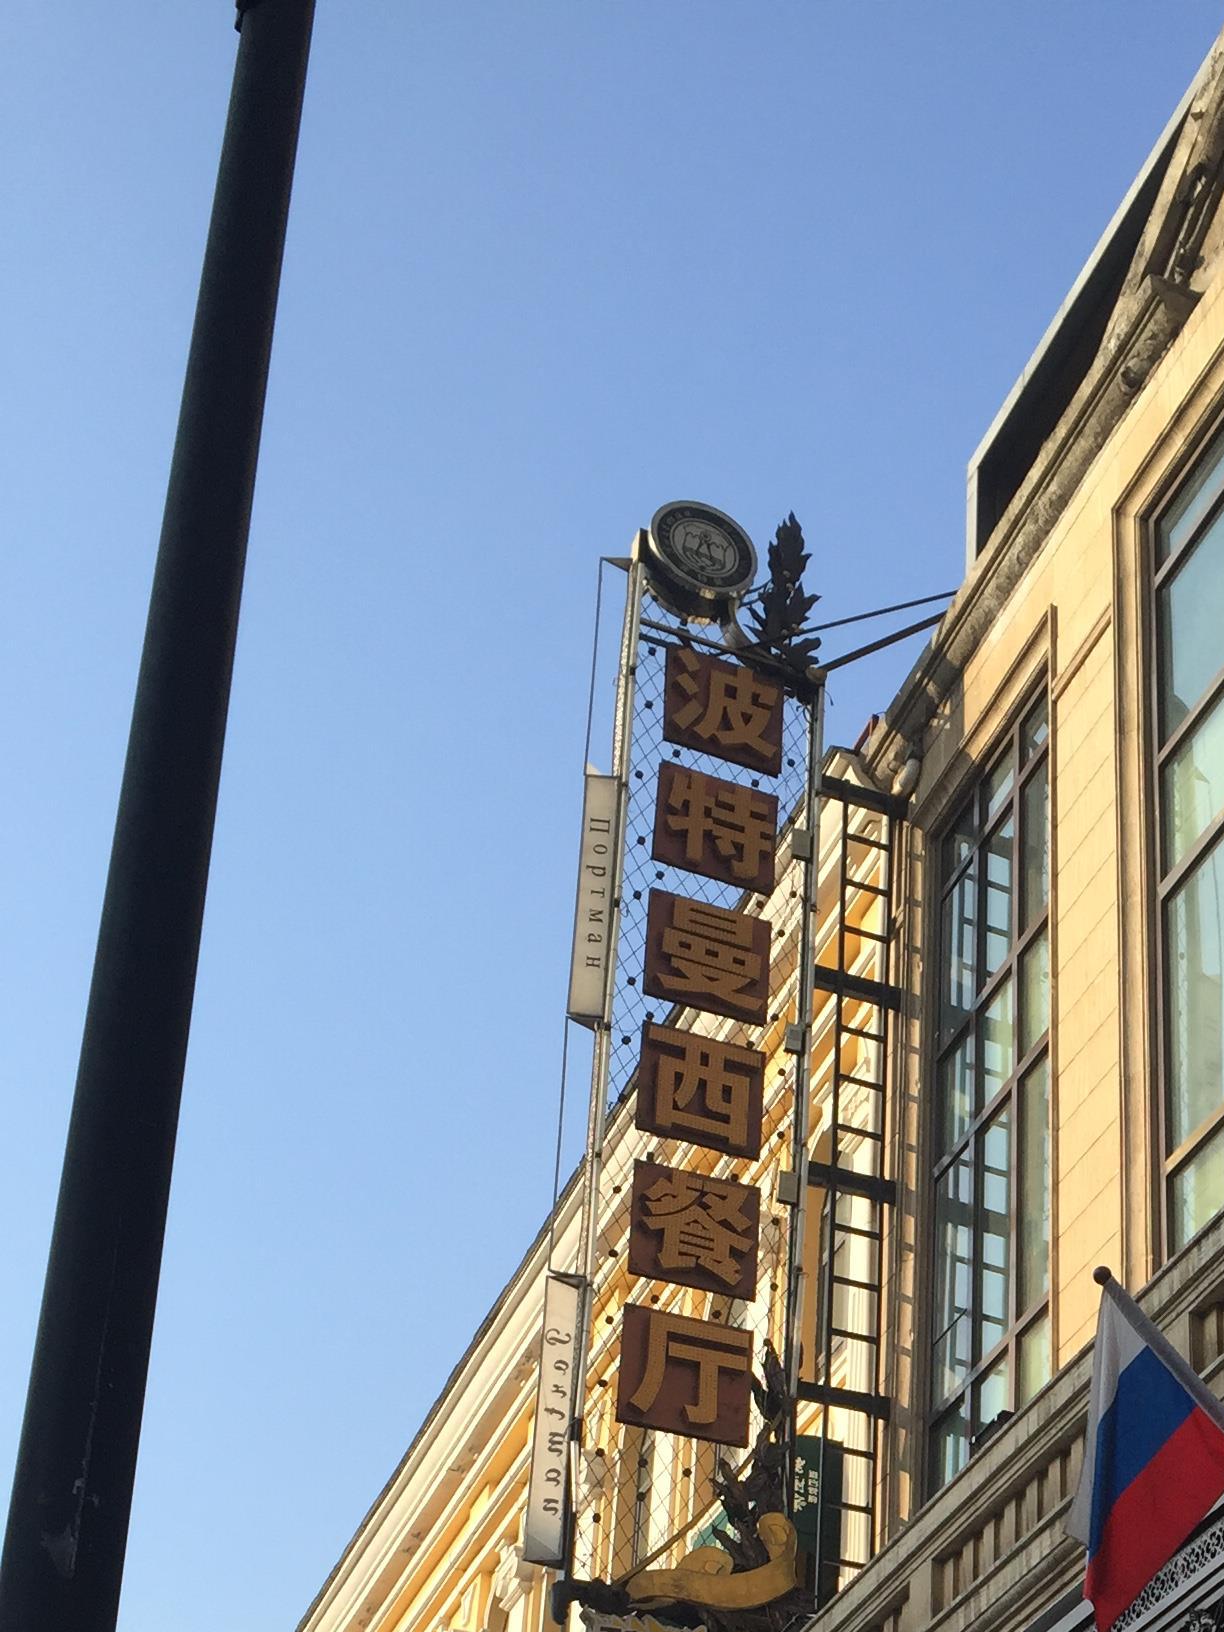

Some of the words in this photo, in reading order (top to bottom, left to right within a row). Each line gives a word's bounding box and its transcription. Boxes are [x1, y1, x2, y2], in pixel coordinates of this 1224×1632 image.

[585, 817, 611, 969] Портман
[628, 647, 779, 1426] 波特曼西餐厅
[543, 1328, 571, 1516] Portman
